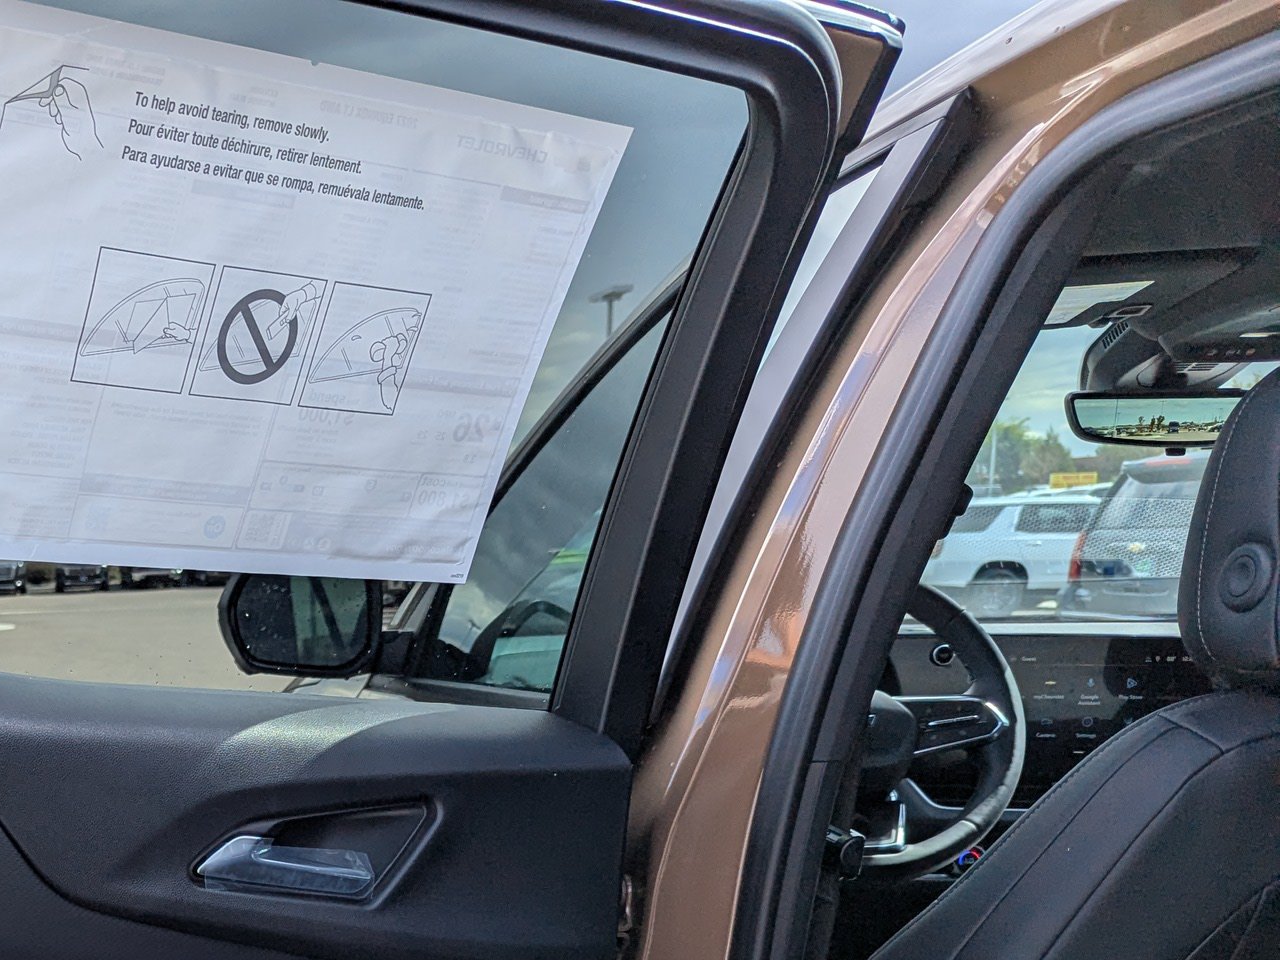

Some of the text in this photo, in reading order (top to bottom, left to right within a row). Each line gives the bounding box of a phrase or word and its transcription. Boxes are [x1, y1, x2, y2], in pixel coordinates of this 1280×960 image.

[135, 91, 330, 144] To help avoid tearing, remove slowly.
[128, 119, 362, 174] Pour éviter toute déchirure, retirer lentement.
[121, 146, 425, 210] Para ayudarse a evitar que se rompa, remuévala lentamente.
